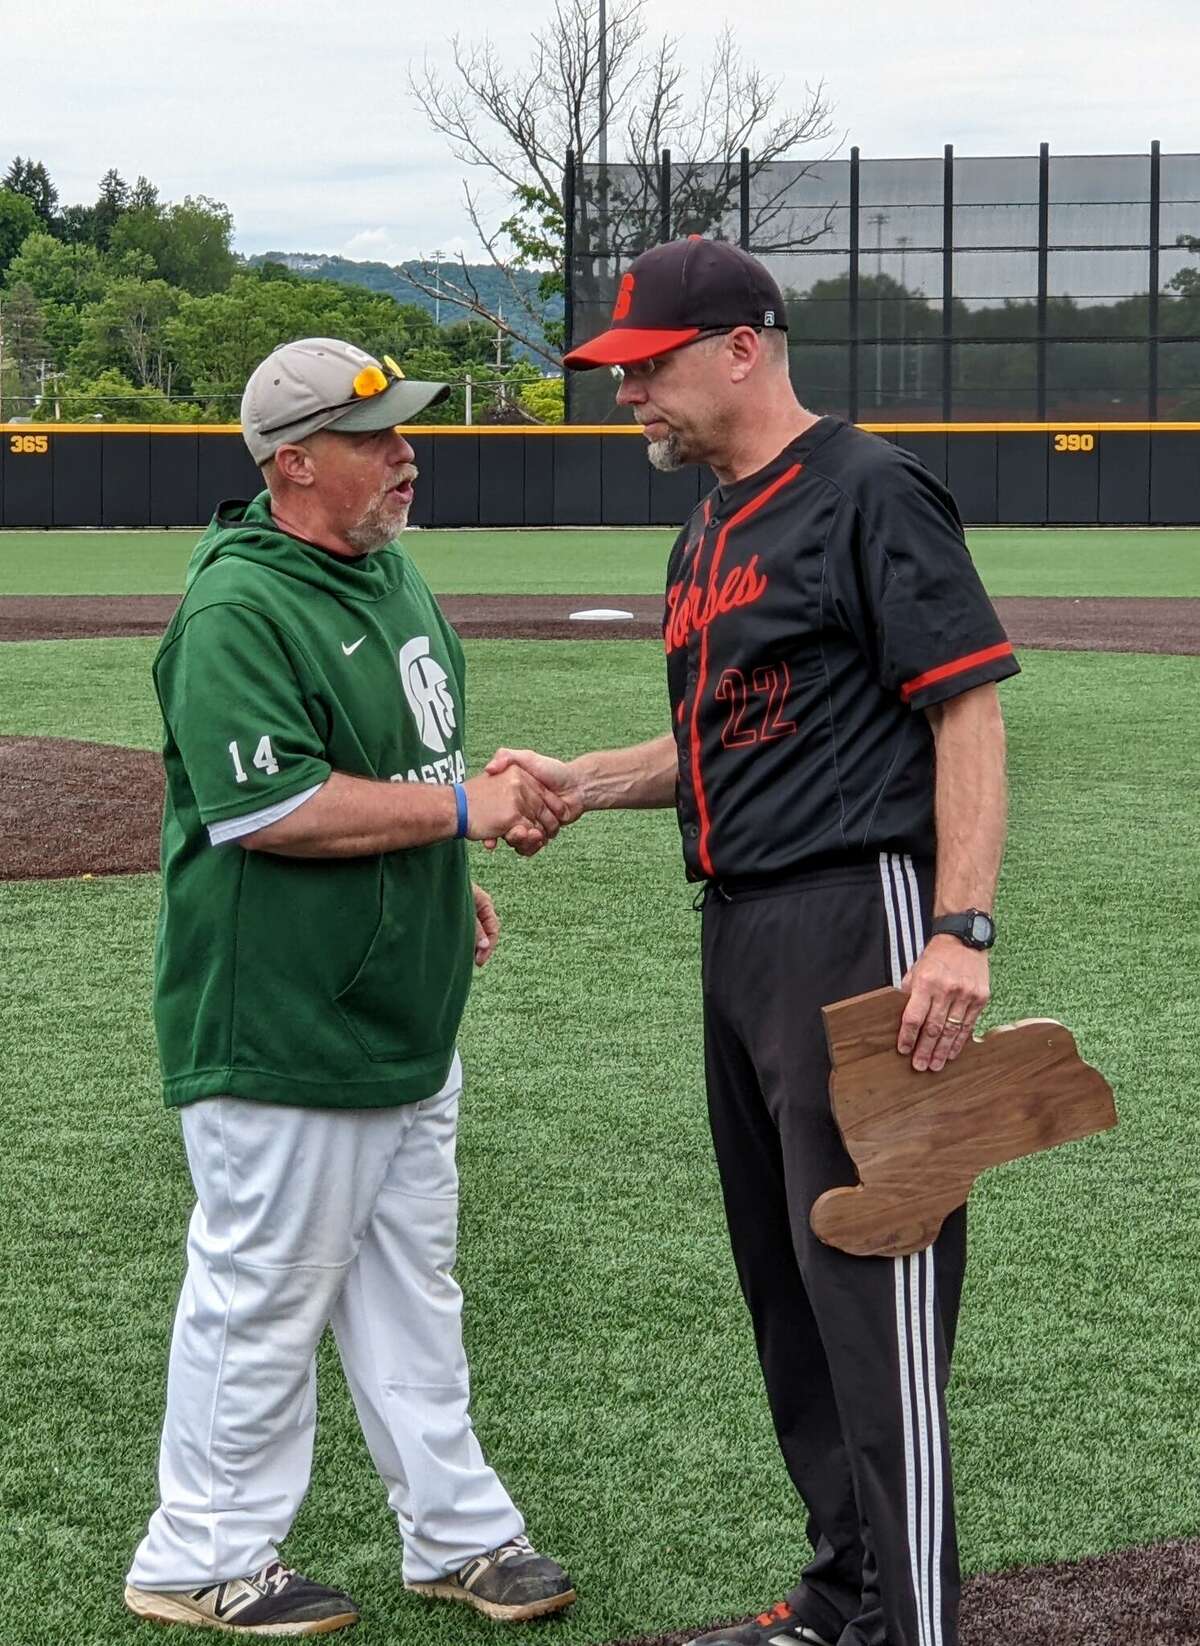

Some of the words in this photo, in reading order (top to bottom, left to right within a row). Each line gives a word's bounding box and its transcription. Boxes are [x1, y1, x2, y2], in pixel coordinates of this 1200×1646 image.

[10, 435, 48, 452] 365
[1055, 434, 1093, 451] 390
[715, 661, 797, 749] 22
[228, 735, 280, 783] 14
